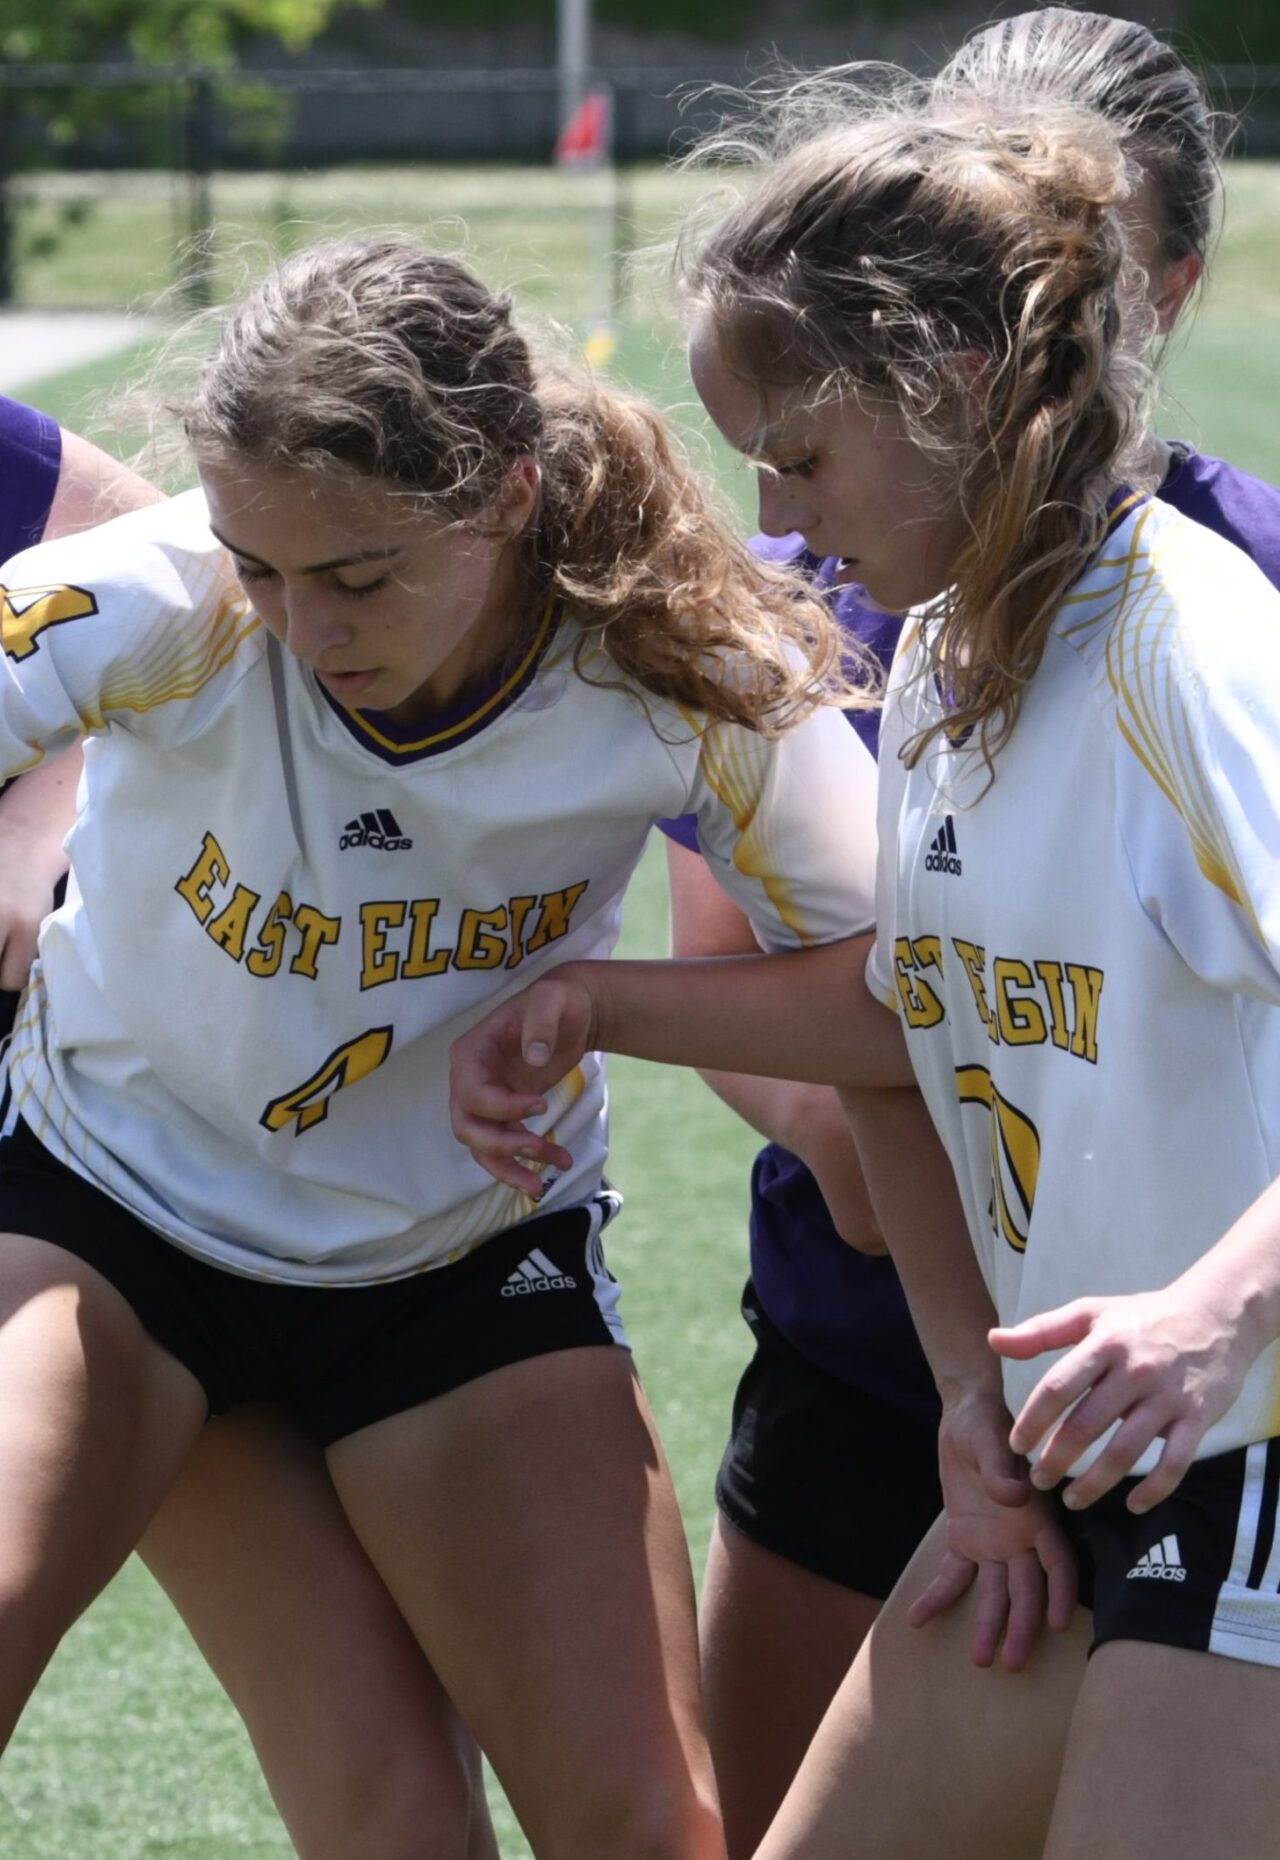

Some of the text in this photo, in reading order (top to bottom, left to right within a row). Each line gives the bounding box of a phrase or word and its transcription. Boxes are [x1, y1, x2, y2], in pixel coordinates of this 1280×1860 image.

[339, 828, 413, 851] adidas
[925, 850, 962, 877] adidas
[174, 830, 590, 992] EAST ELGIN
[500, 1275, 577, 1297] adidas
[1126, 1562, 1187, 1582] adidas
